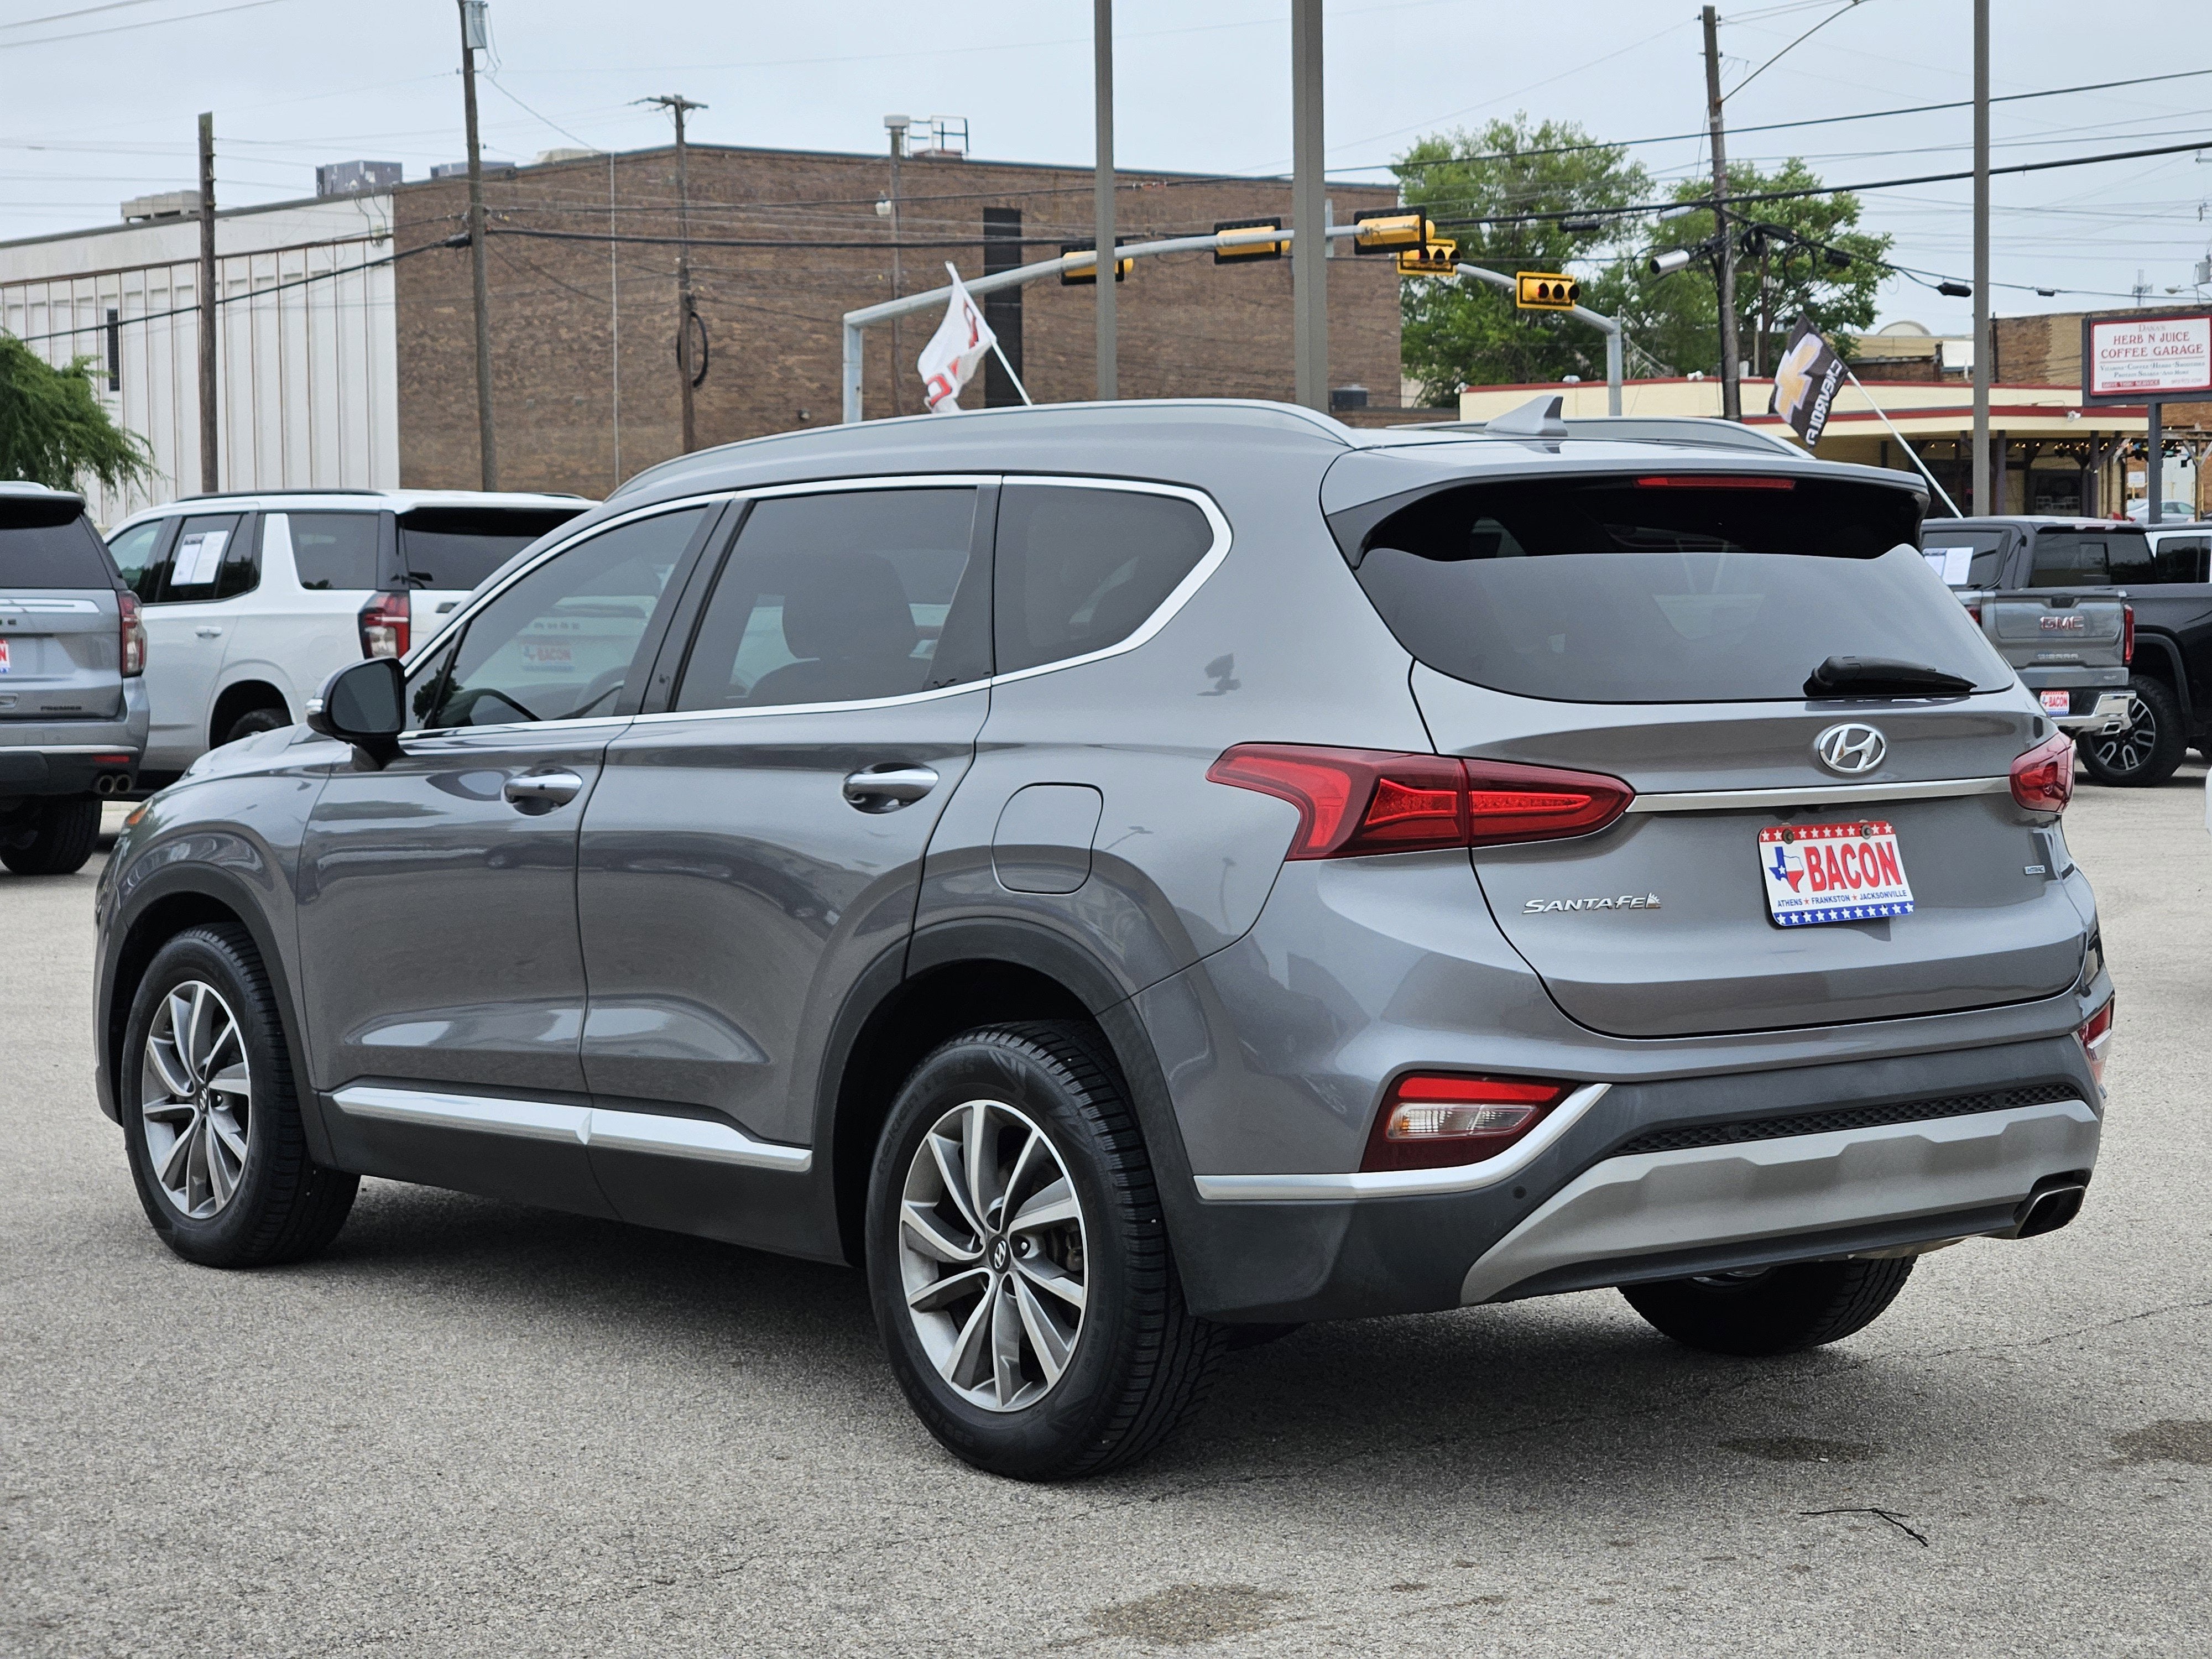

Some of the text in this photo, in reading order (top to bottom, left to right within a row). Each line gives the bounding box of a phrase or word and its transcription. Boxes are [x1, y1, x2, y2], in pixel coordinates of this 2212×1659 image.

[2114, 332, 2190, 345] HERB N JUICE
[2101, 343, 2204, 359] COFFEE GARAGE
[2040, 615, 2084, 630] GMC
[2048, 696, 2068, 707] BACON
[1804, 841, 1903, 892] BACON
[1777, 889, 1907, 908] ATHENS FRANKSTON JACKSONVILLE
